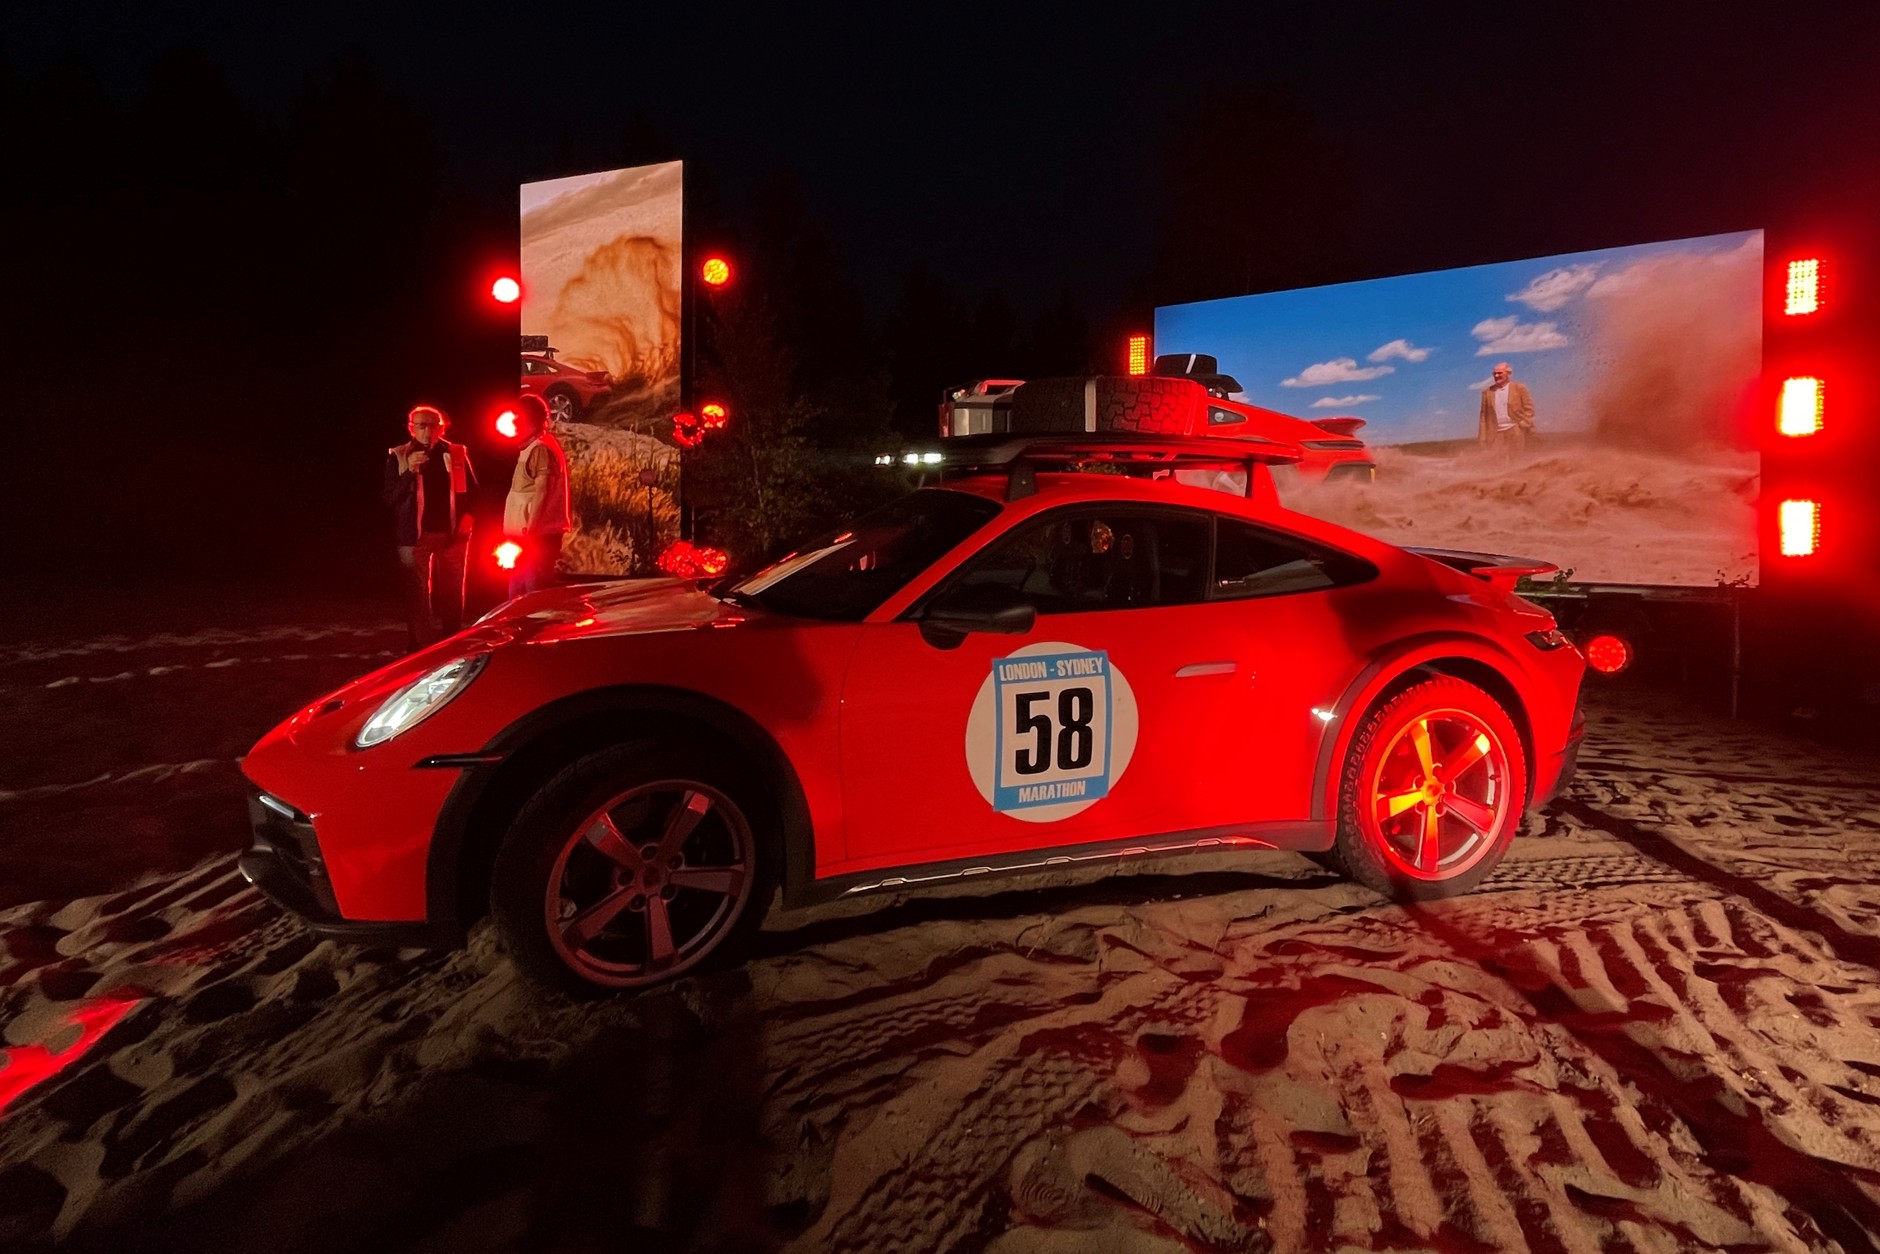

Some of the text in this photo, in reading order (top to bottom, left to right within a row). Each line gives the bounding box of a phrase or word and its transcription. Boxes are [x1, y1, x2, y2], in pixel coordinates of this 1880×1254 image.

[999, 661, 1047, 681] LONDON
[1057, 657, 1103, 677] SYDNEY
[1015, 687, 1093, 775] 58
[1019, 780, 1086, 803] MARATHON
